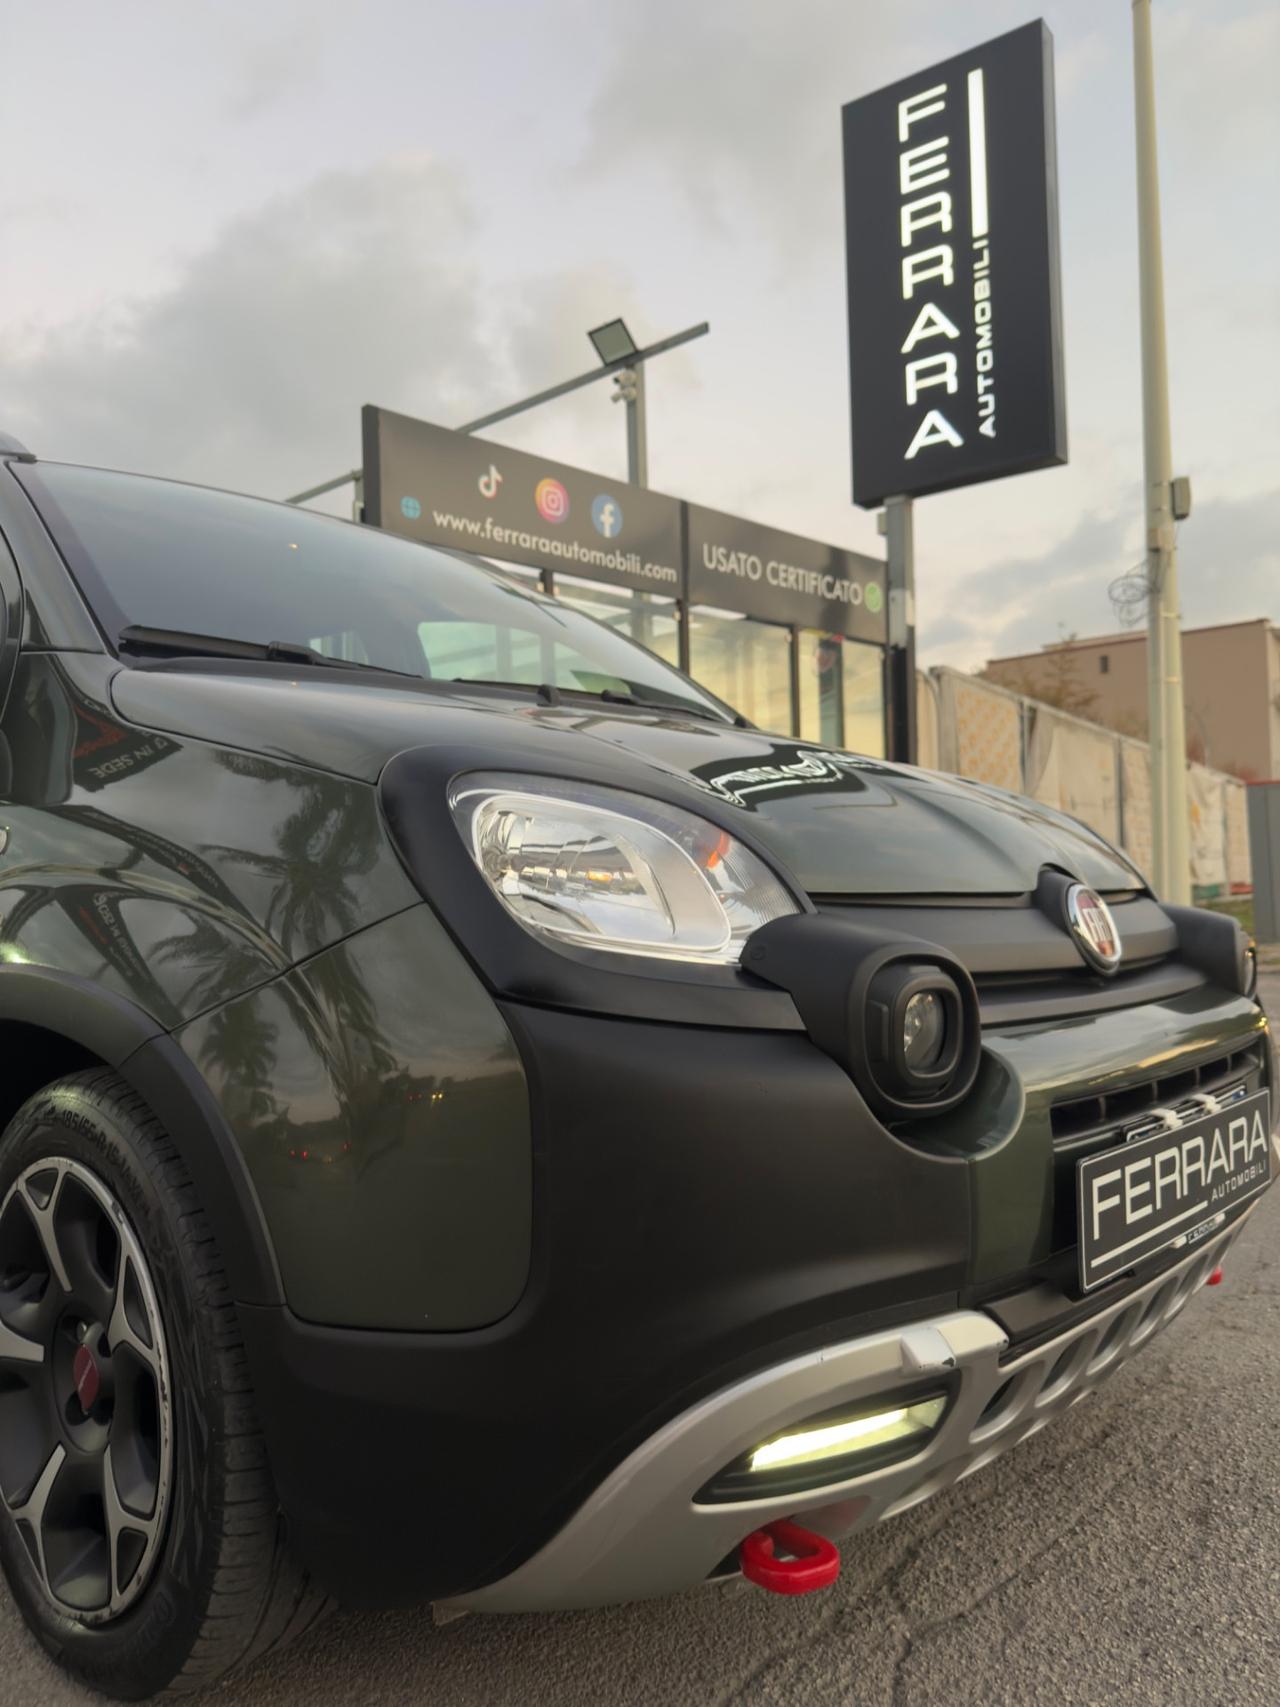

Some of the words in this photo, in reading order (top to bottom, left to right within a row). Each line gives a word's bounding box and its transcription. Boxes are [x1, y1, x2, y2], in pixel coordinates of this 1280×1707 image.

[898, 83, 965, 460] FERRARA
[972, 238, 997, 438] AUTOMOBILI
[432, 510, 678, 583] www.ferraraautomobili.com
[703, 544, 762, 581] USATO
[766, 561, 863, 605] CERTIFICATO
[1092, 1110, 1267, 1241] FERRARA
[1211, 1160, 1267, 1202] AUTOMOBILI
